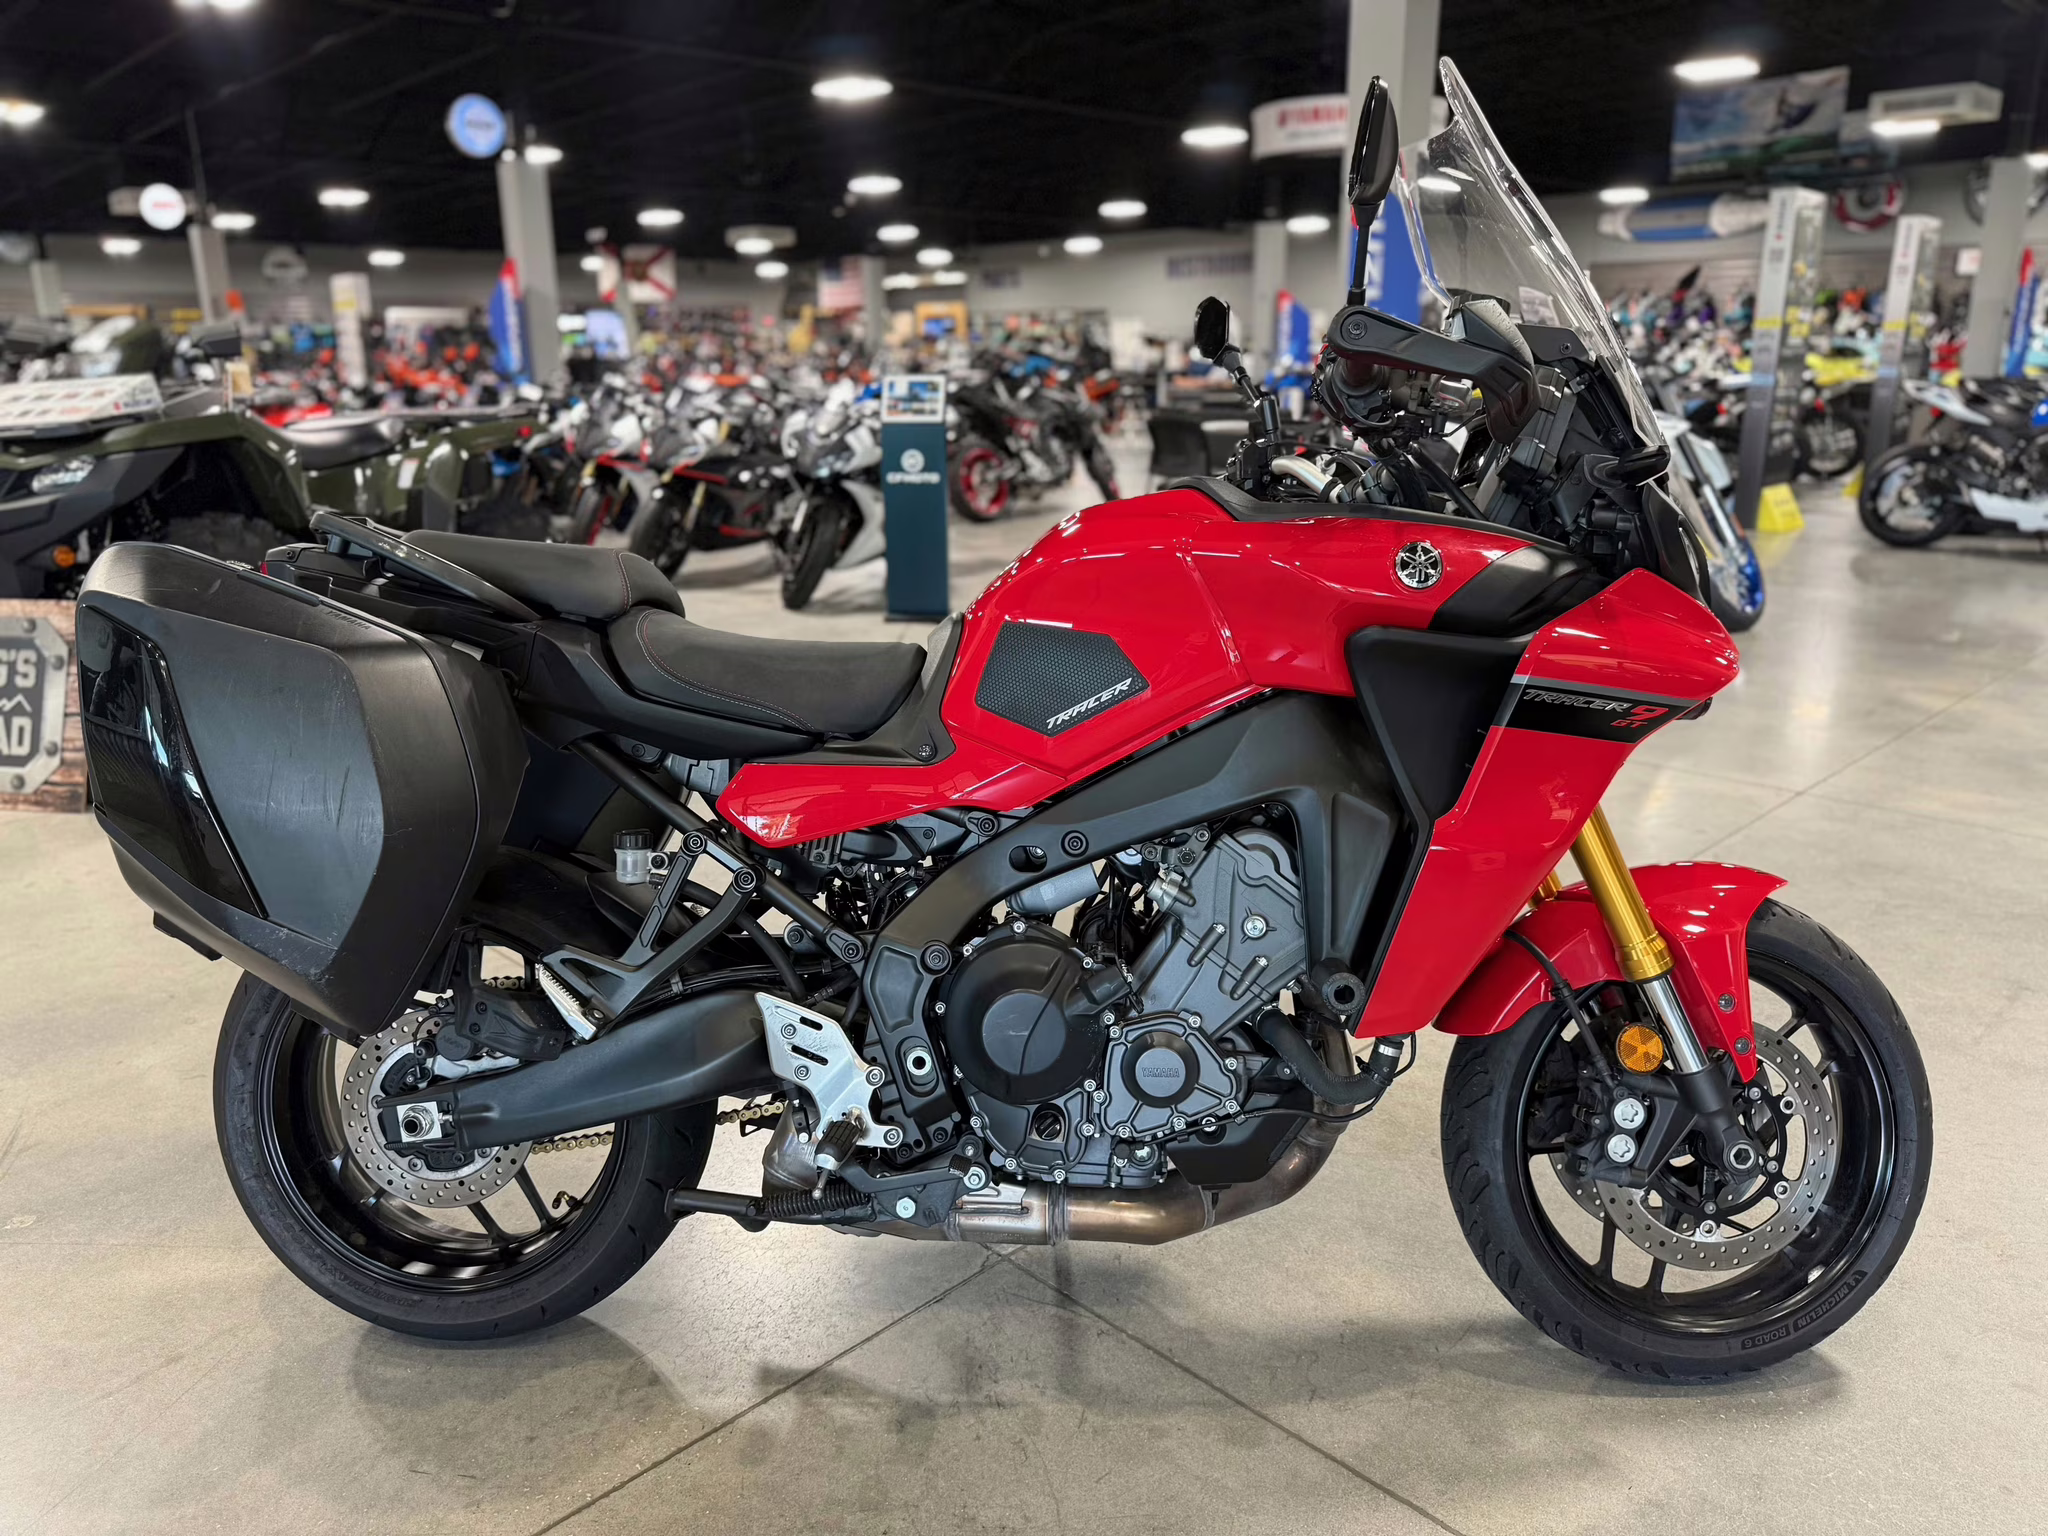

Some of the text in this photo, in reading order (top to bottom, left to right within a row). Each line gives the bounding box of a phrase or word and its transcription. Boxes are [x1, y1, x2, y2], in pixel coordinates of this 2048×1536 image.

[1046, 677, 1132, 729] TRACER
[1523, 689, 1669, 721] TRACER 9
[1610, 719, 1648, 728] GT
[1141, 1067, 1180, 1078] YAMAHA
[1797, 1281, 1850, 1329] MICHELIN
[1744, 1326, 1787, 1349] ROAD 6
